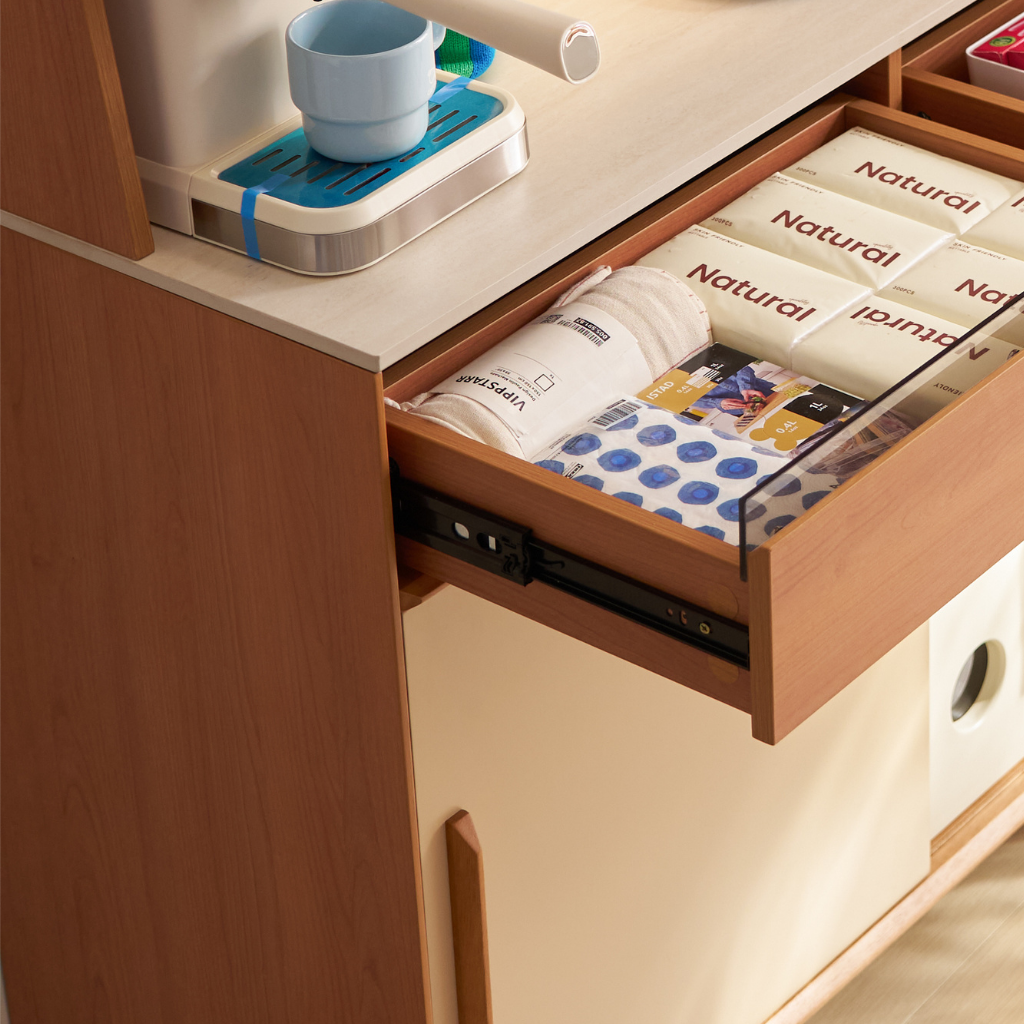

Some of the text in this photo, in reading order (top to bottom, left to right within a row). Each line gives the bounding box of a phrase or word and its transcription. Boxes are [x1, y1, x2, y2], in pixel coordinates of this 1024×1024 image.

[854, 161, 981, 215] Natural
[770, 209, 901, 268] Natural
[686, 263, 817, 322] Natural
[850, 306, 990, 361] Natural
[456, 375, 526, 412] VIPPSTARR
[646, 381, 674, 400] ISTAD
[776, 420, 797, 434] 0.4L
